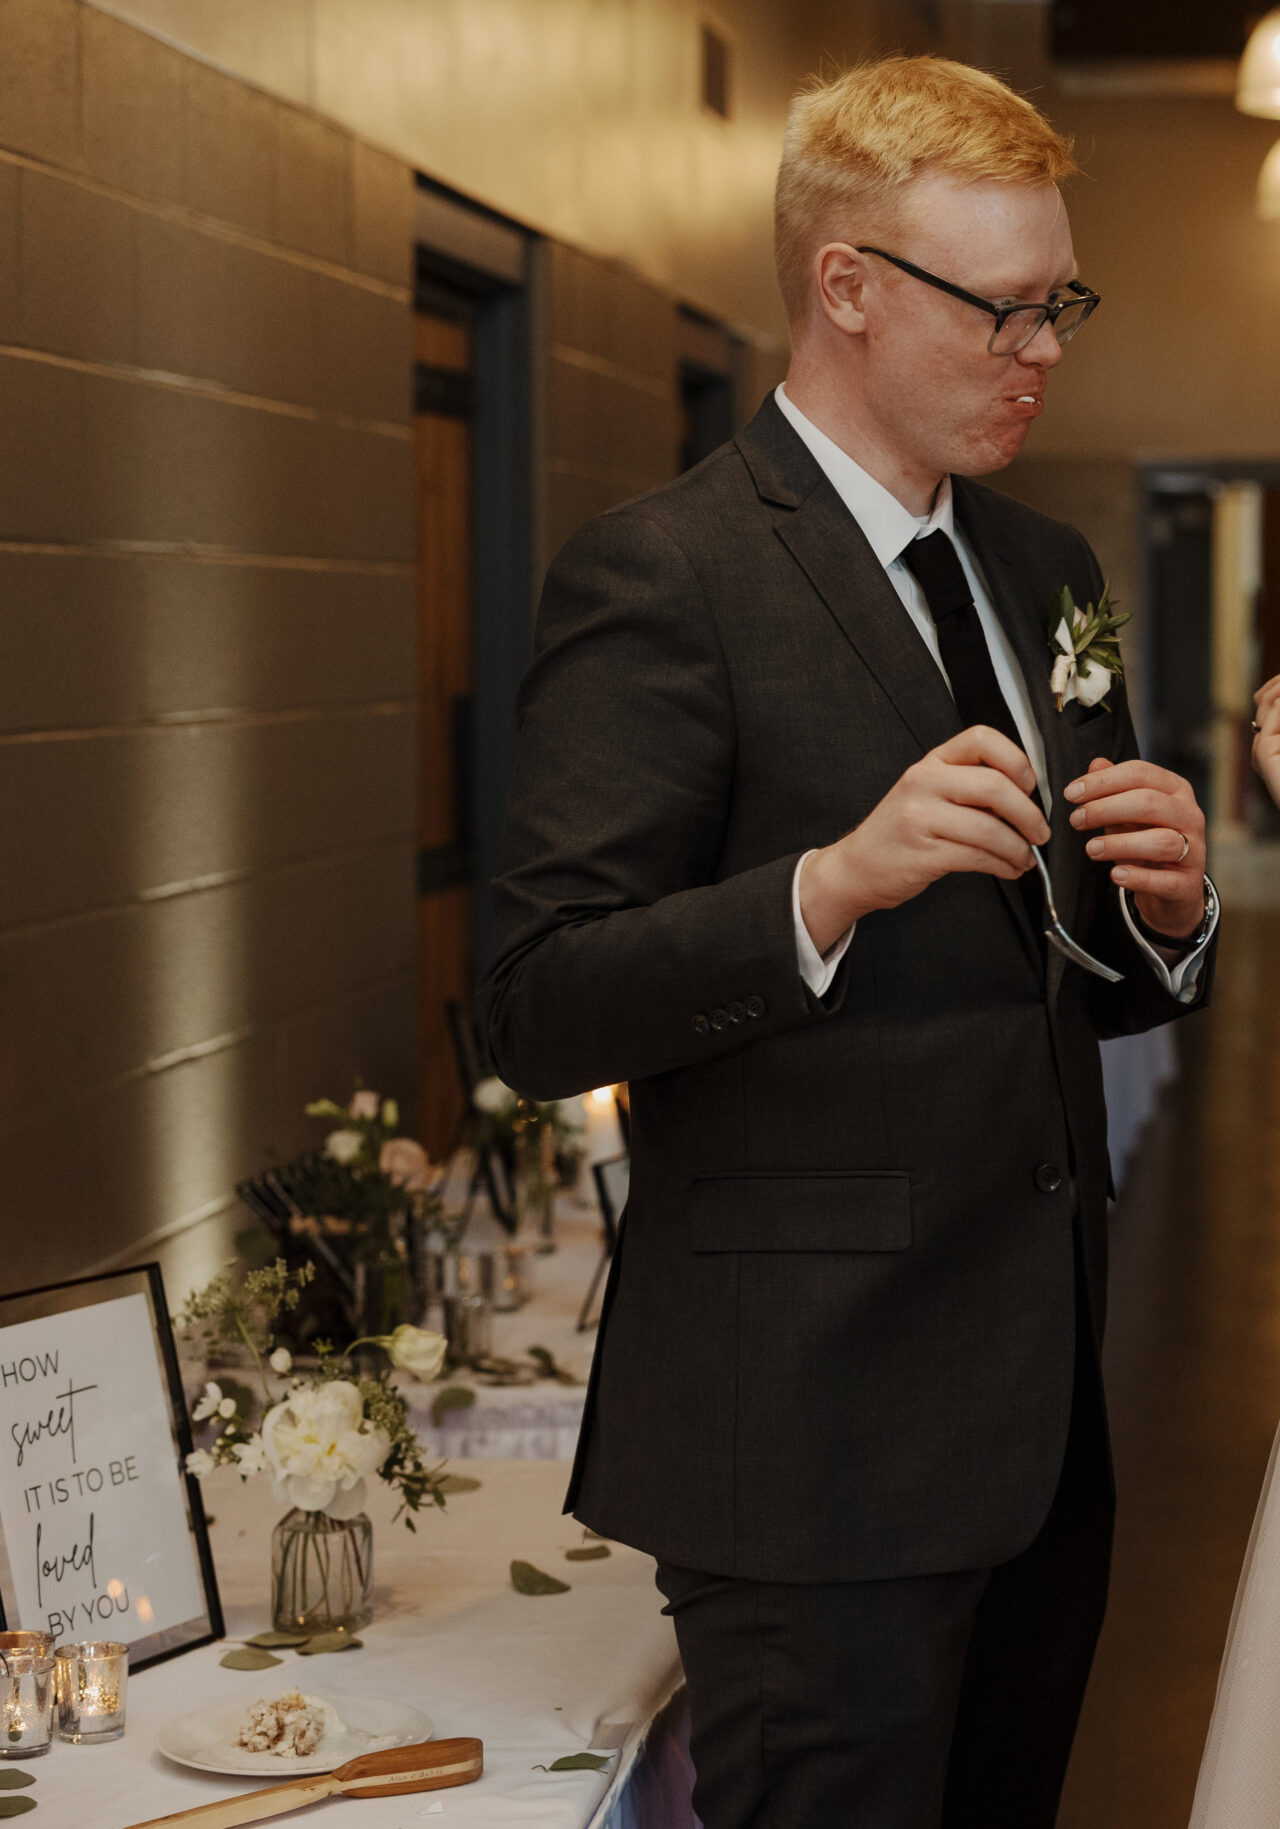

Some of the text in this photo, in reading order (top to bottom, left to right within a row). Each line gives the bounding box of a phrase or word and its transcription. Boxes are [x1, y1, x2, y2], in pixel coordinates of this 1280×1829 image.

[1, 1350, 58, 1388] HOW
[11, 1377, 98, 1467] sweet
[24, 1456, 139, 1513] IT IS TO BE
[36, 1512, 97, 1608] loved
[48, 1587, 129, 1638] BY YOU
